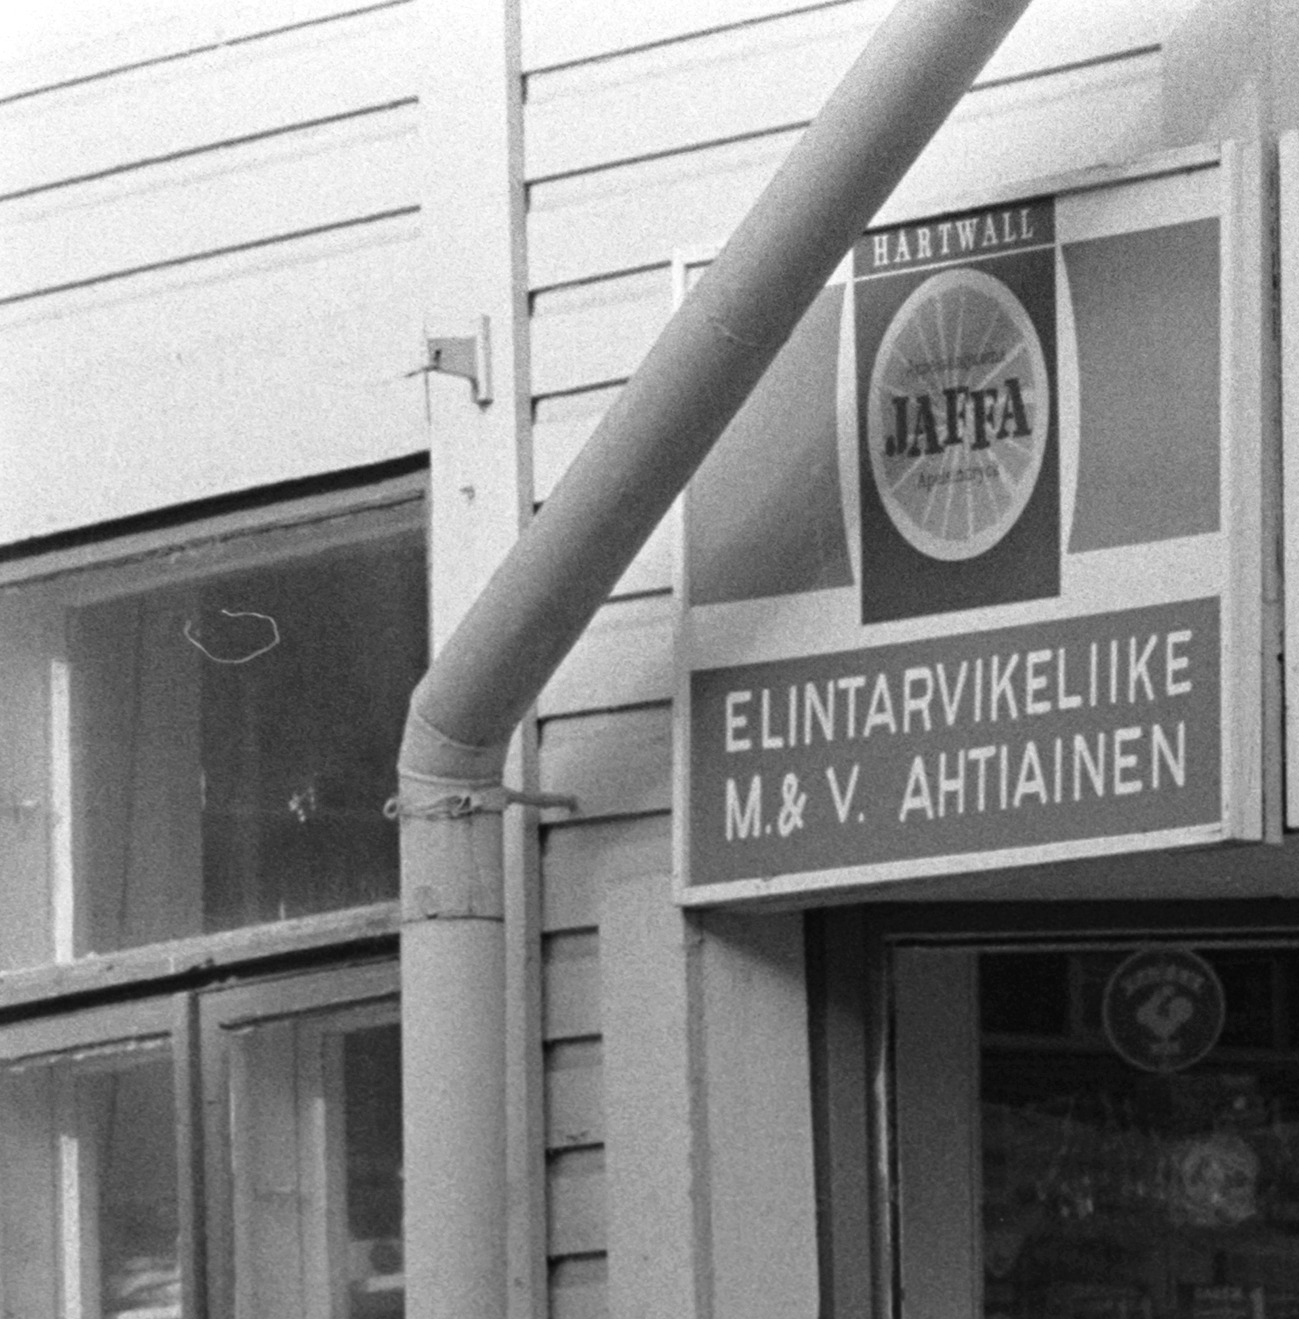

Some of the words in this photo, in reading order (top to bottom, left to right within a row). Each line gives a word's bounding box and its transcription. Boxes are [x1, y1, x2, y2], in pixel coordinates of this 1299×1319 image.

[872, 208, 1035, 267] HARTWALL
[885, 378, 1032, 457] JAFFA
[724, 630, 1193, 752] ELINTARVIKELIIKE
[827, 764, 864, 824] V.
[900, 721, 1187, 822] AHTIAINEN
